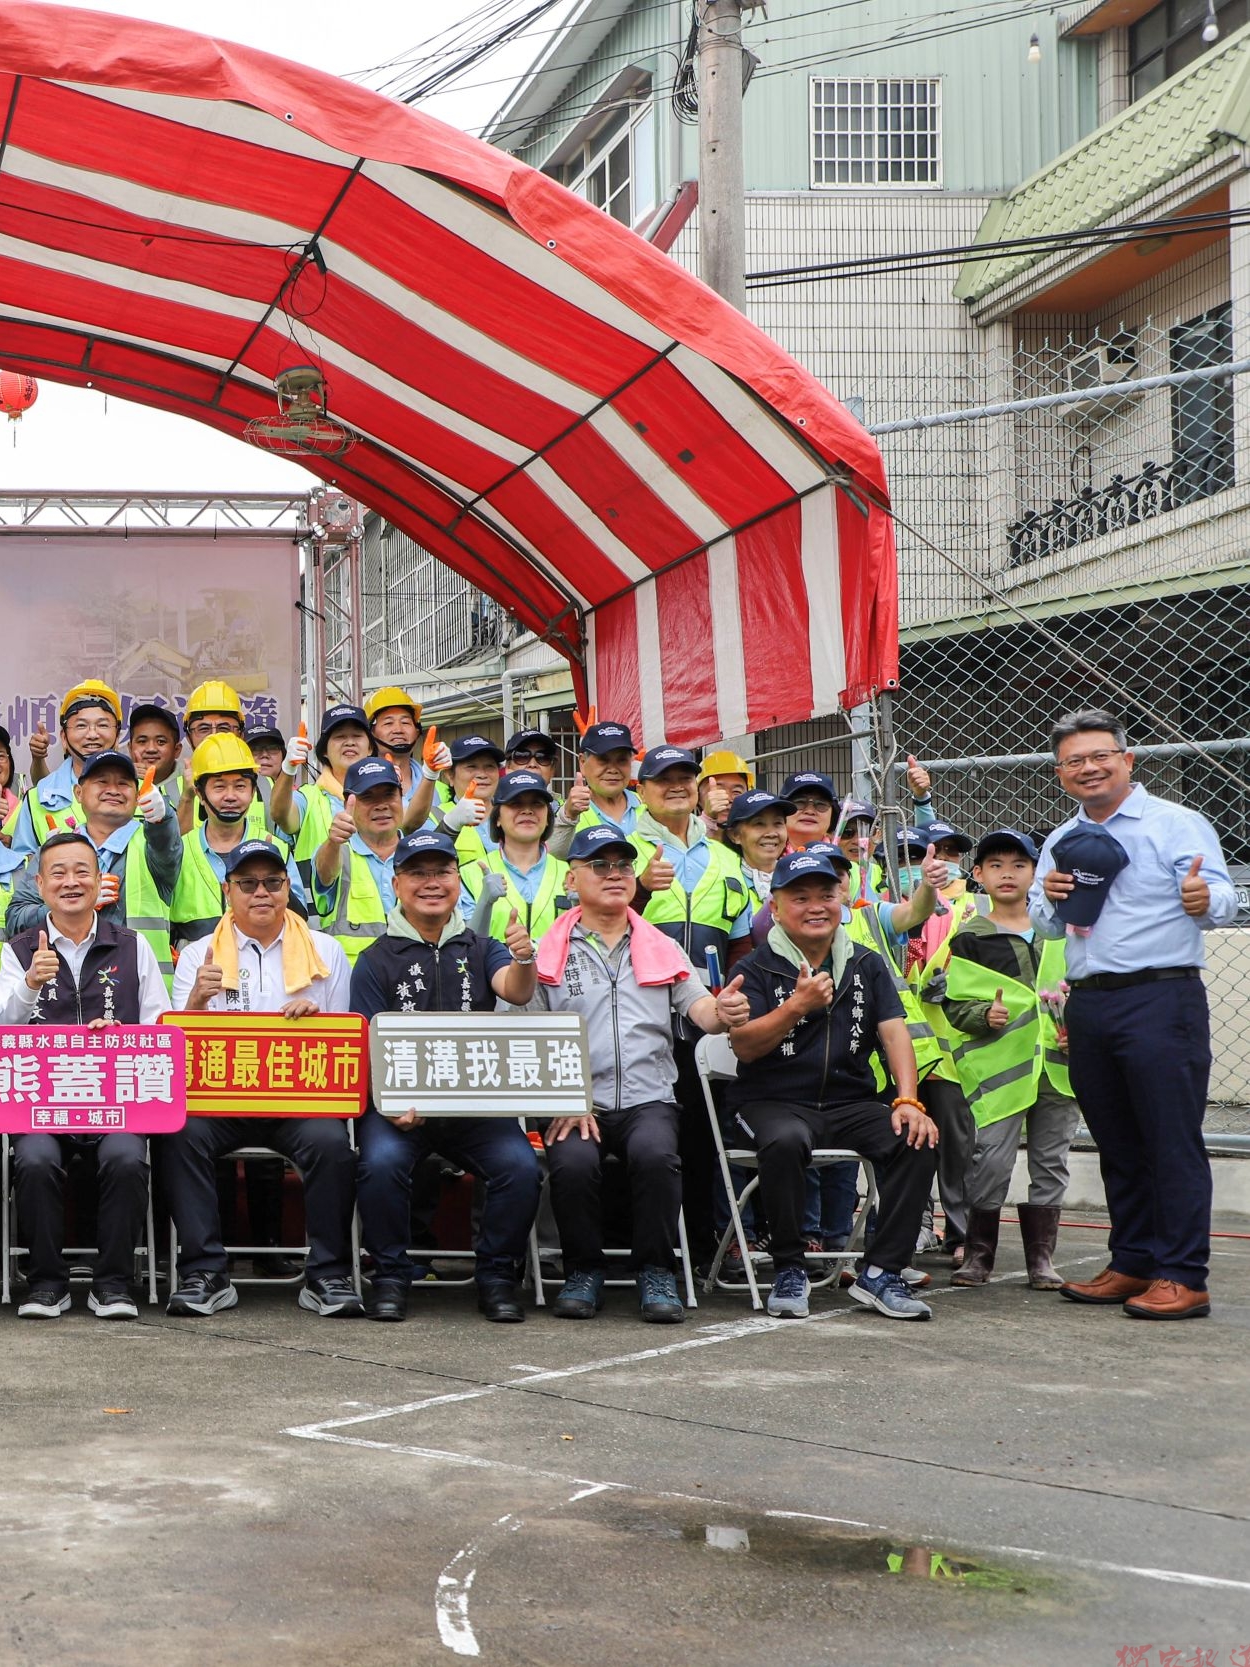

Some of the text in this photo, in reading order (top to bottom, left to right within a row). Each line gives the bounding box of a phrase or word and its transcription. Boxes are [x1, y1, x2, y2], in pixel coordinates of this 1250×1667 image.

[103, 985, 115, 1025] 嘉義縣
[225, 988, 241, 1012] 陳
[849, 973, 864, 1055] 民雄鄉公所
[384, 1040, 584, 1088] 清溝我最強
